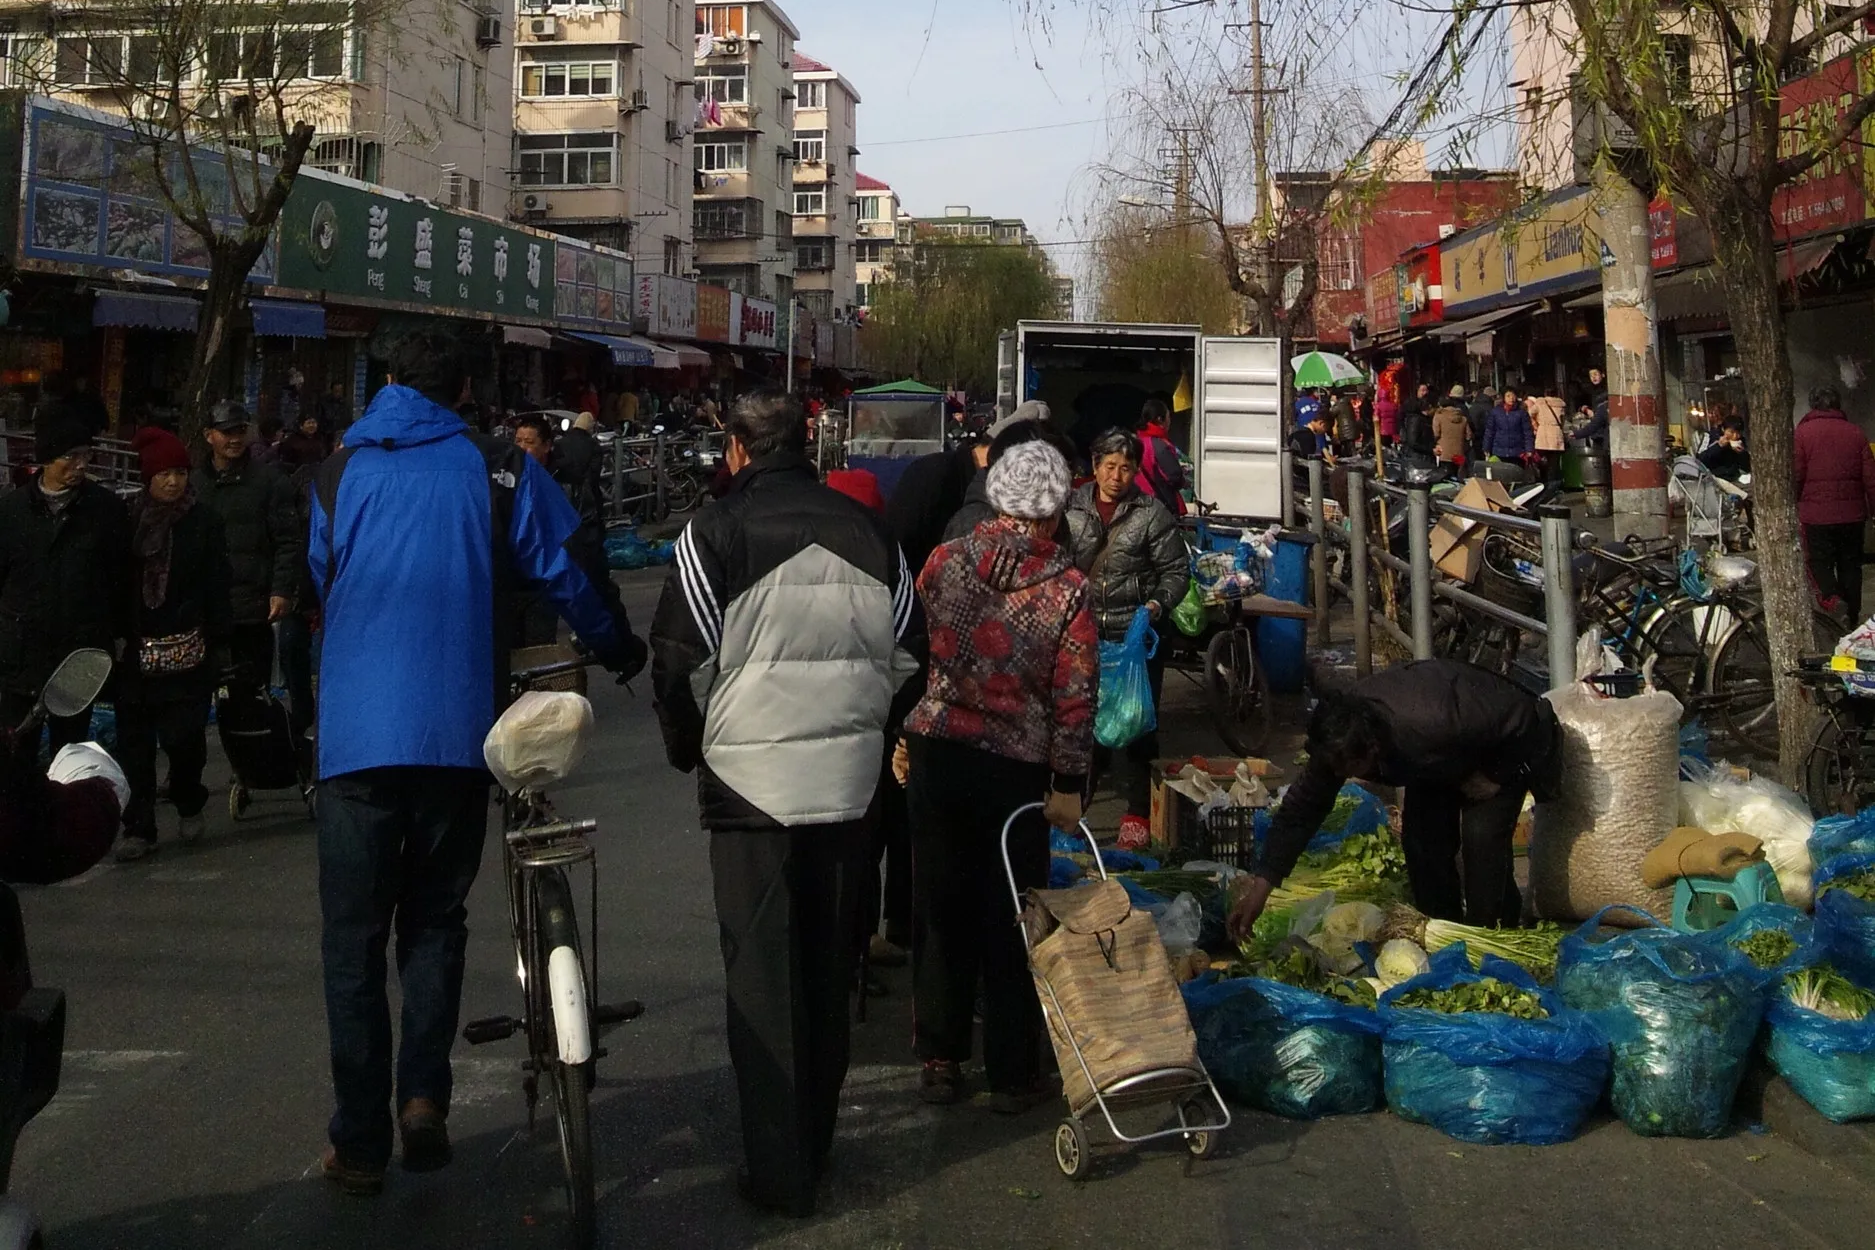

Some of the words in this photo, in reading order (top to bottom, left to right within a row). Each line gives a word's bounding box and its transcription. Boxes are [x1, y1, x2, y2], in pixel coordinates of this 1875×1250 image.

[367, 205, 541, 289] 彭盛菜市场
[367, 268, 385, 291] Peng
[413, 275, 432, 298] Sheng
[459, 283, 469, 299] Cai
